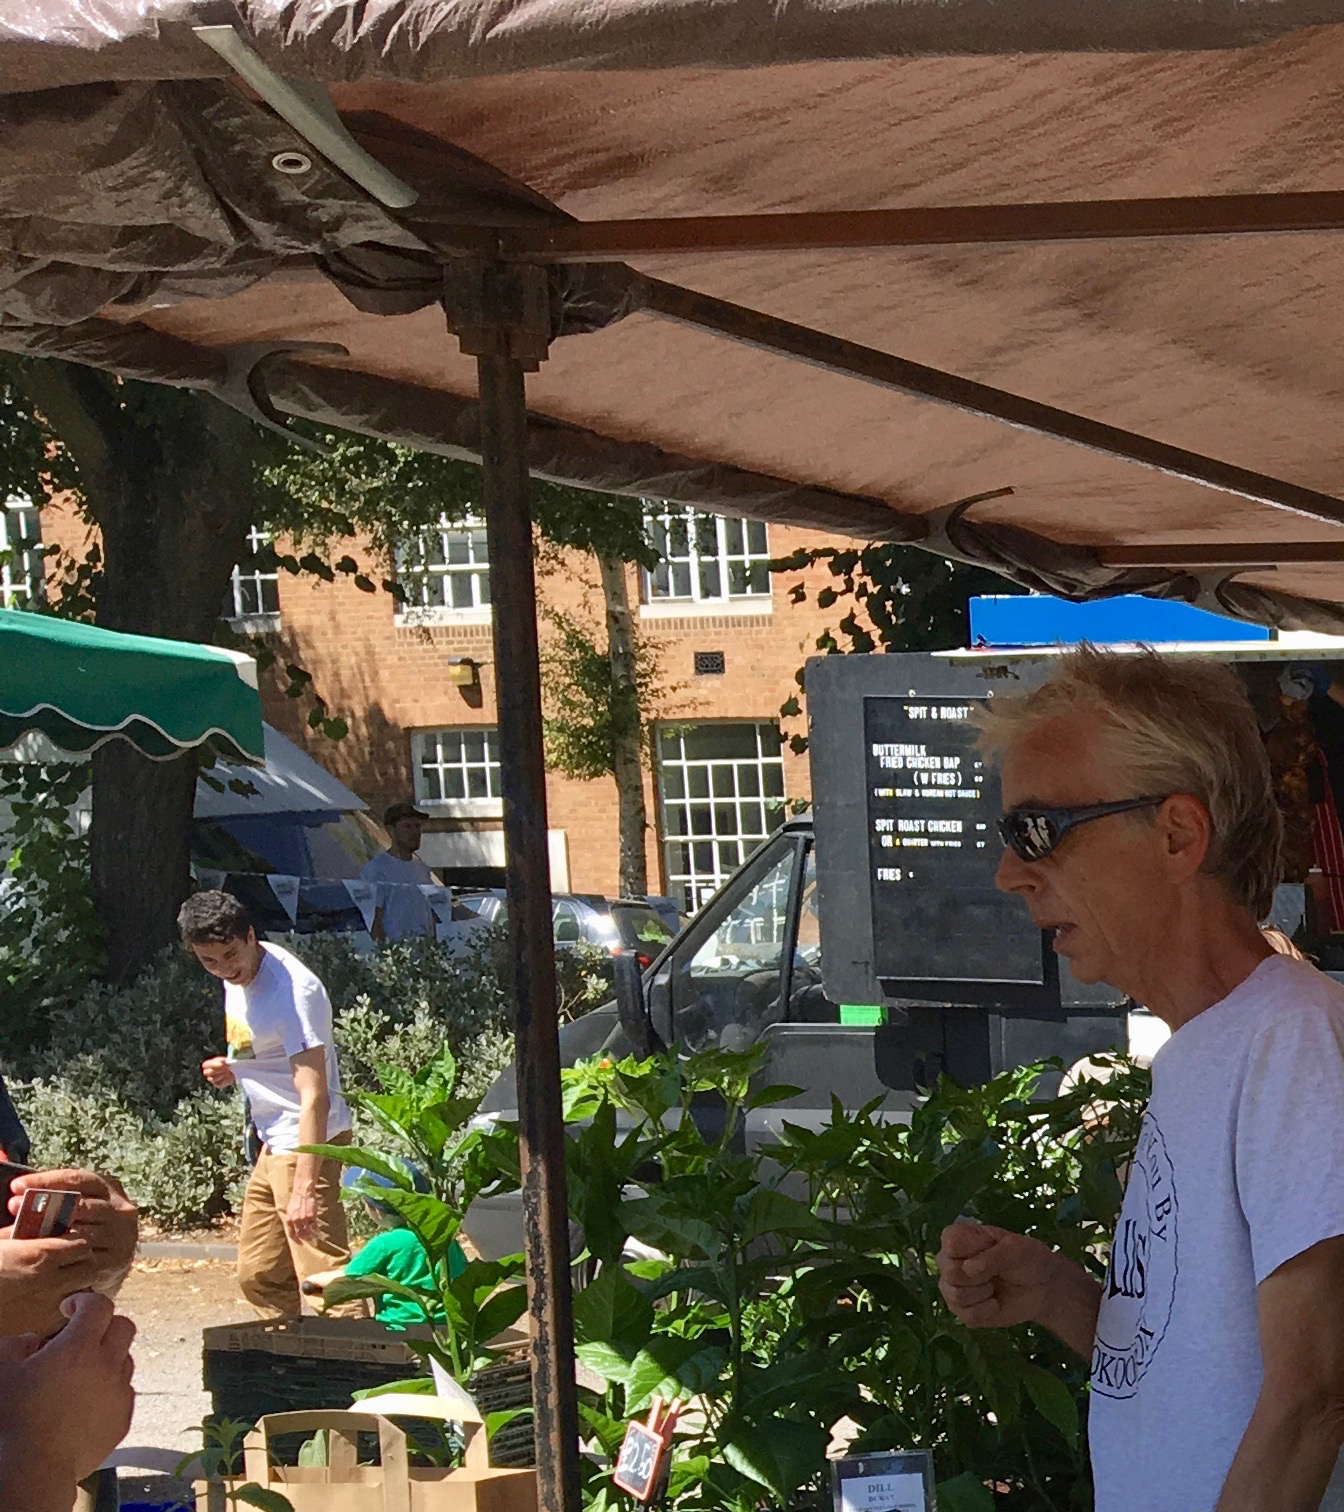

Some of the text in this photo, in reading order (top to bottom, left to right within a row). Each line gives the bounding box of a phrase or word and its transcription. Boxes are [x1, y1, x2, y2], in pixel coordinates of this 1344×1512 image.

[931, 706, 938, 719] &
[872, 744, 927, 757] BUTTERMILK
[880, 756, 904, 769] FRIED
[906, 757, 941, 769] CHICKEN
[943, 757, 961, 769] BAP
[875, 819, 895, 832] SPIT
[897, 819, 925, 832] ROAST
[927, 820, 963, 833] CHICKEN
[881, 835, 893, 847] OR
[877, 867, 902, 881] FRIES
[868, 1483, 893, 1493] DILL
